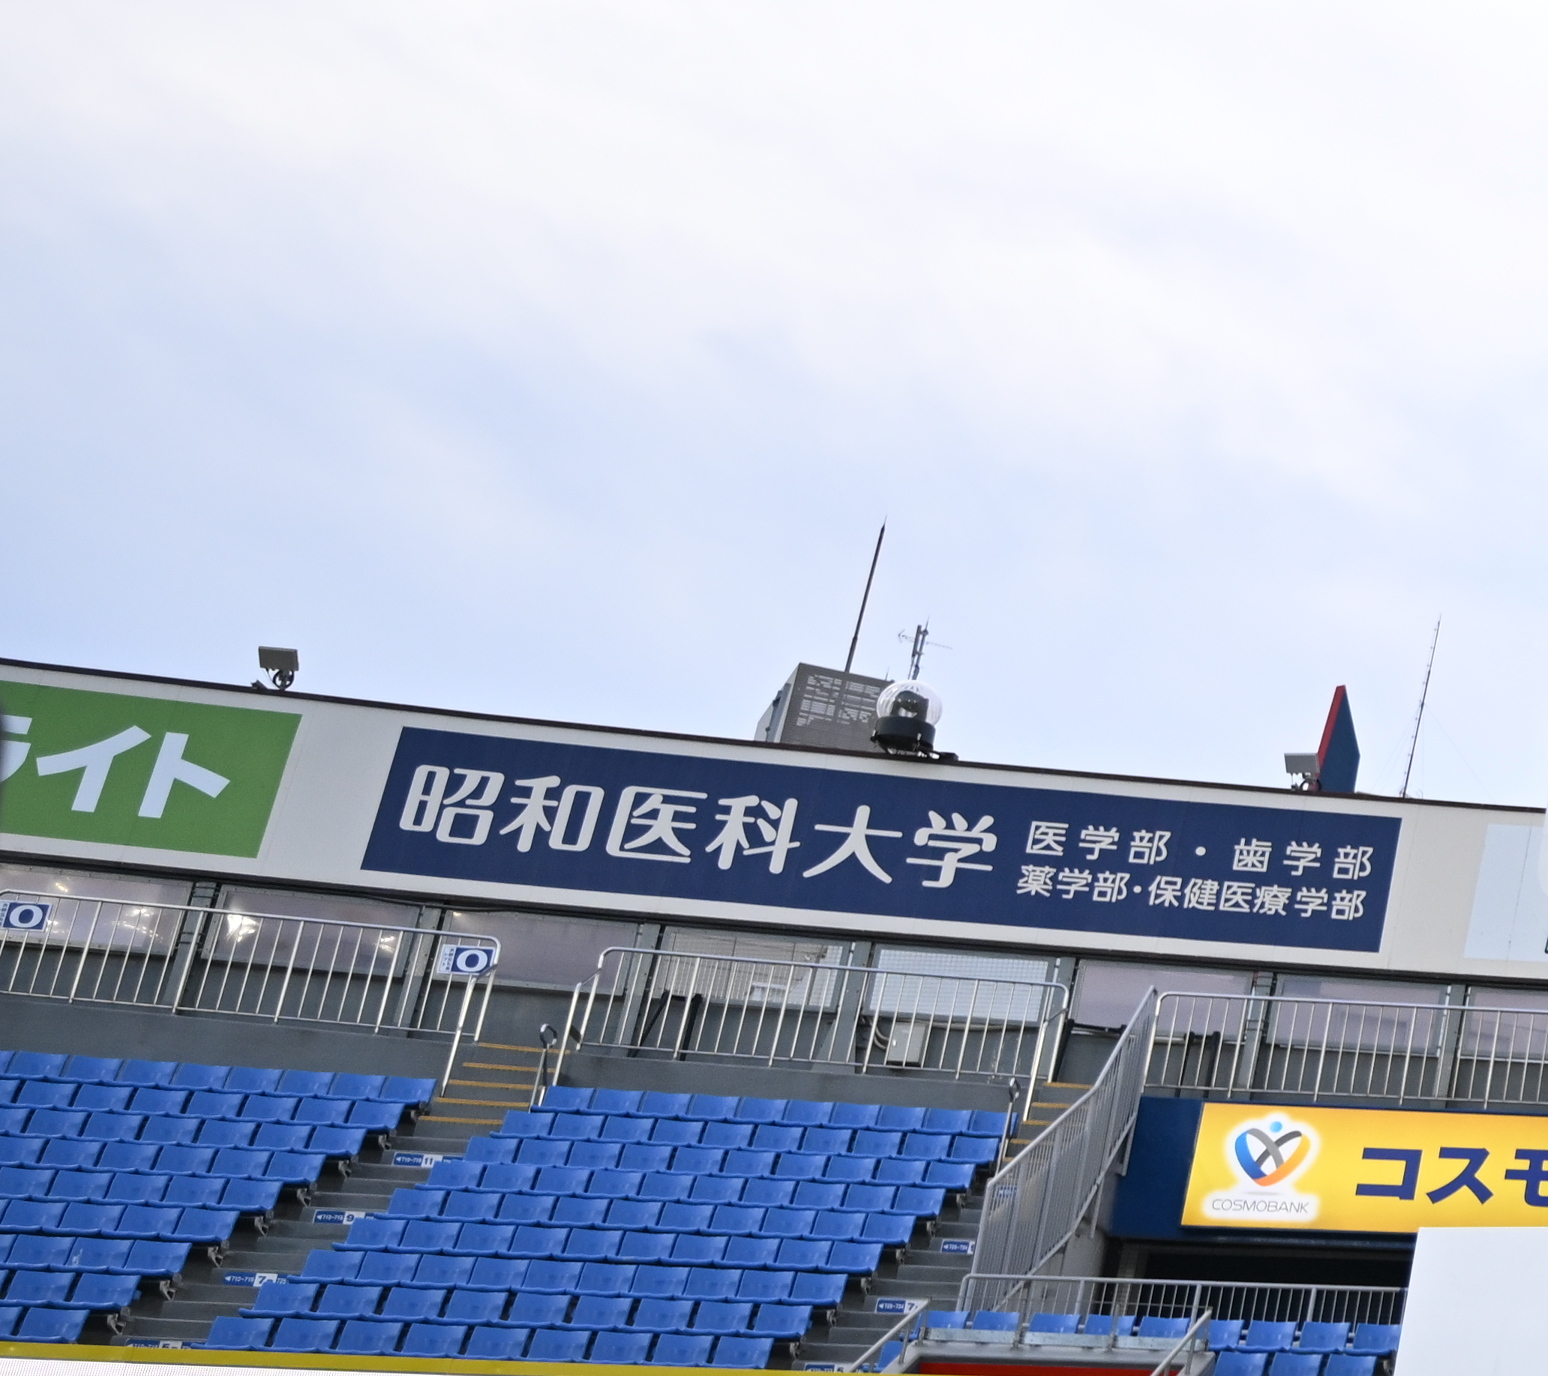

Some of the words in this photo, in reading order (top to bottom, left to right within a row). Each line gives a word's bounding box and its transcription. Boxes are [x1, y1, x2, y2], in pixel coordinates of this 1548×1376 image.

[401, 764, 997, 890] 昭和医科大学
[1025, 820, 1374, 881] 医学部・歯学部
[1016, 864, 1366, 922] 薬学部・保健医療学部
[1210, 1195, 1310, 1216] COSMOBANK
